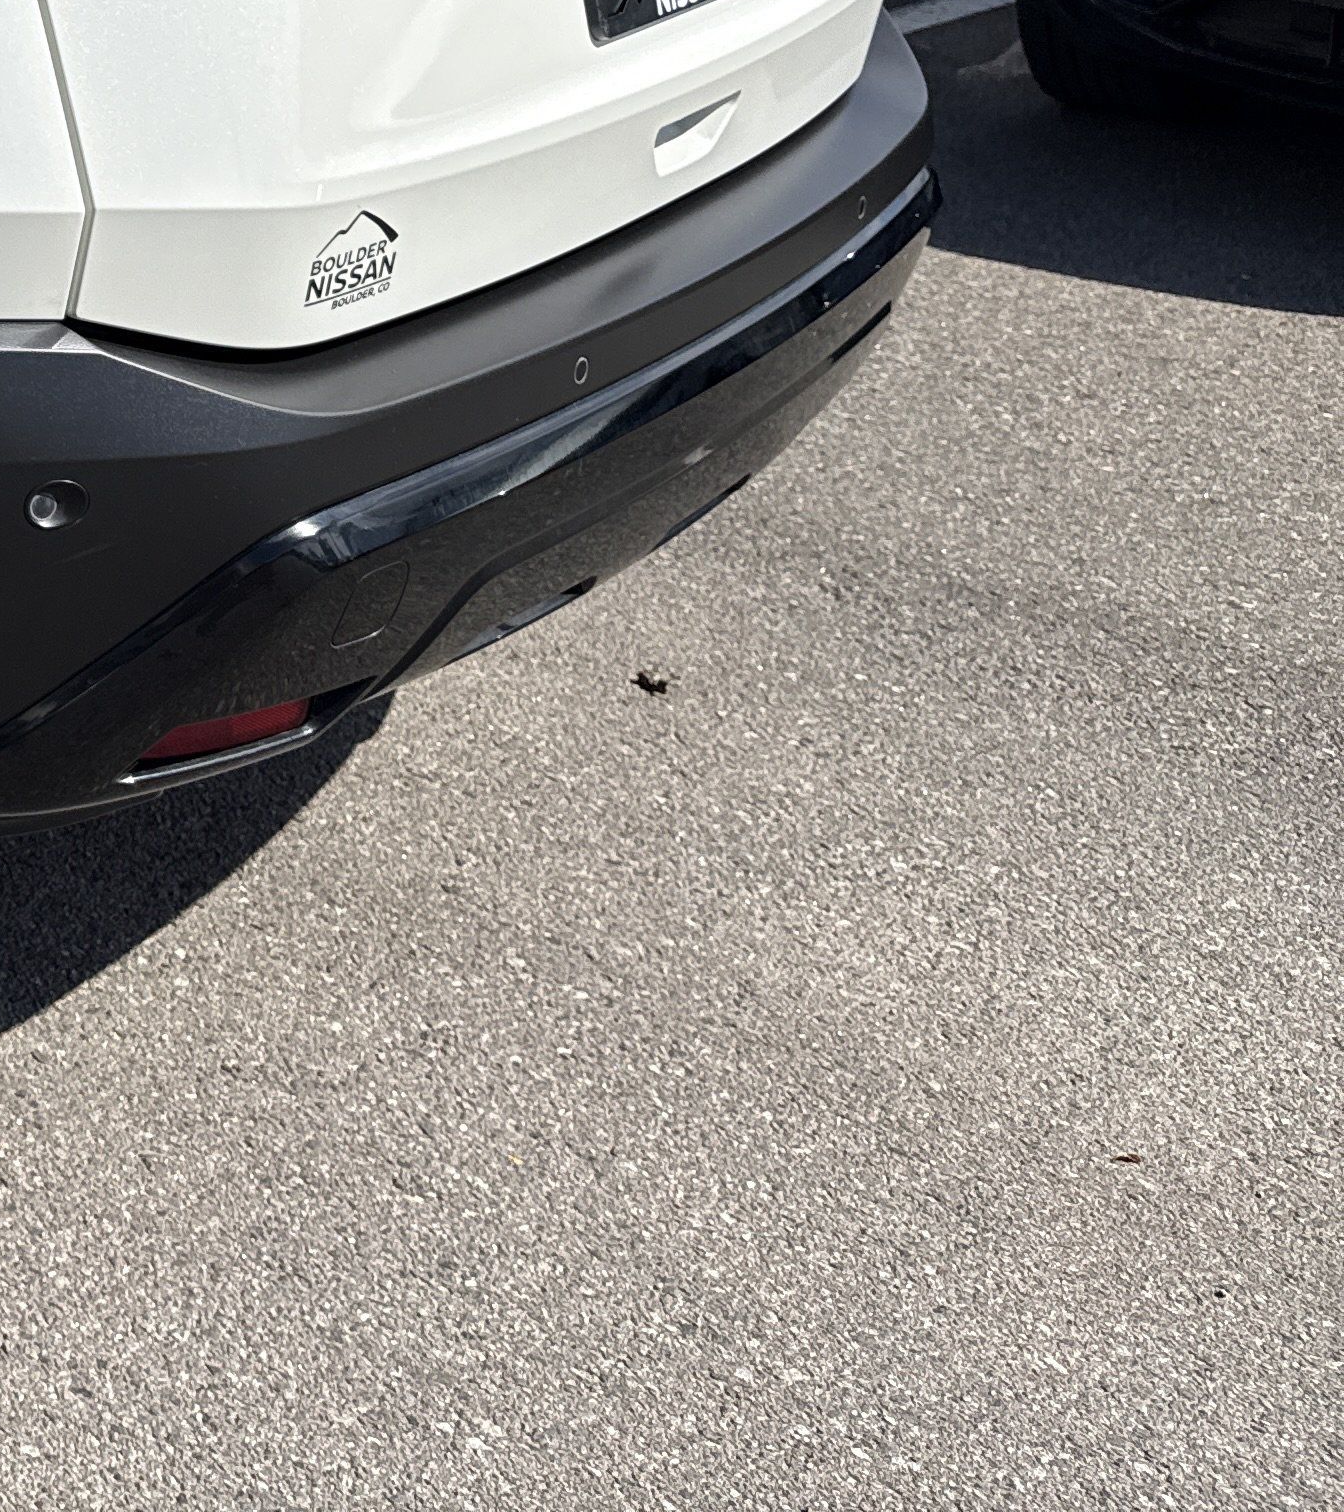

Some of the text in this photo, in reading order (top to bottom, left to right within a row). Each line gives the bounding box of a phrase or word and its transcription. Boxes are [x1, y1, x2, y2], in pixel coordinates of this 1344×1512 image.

[310, 239, 387, 276] BOULDER
[304, 251, 397, 302] NISSAN
[377, 281, 390, 293] CO
